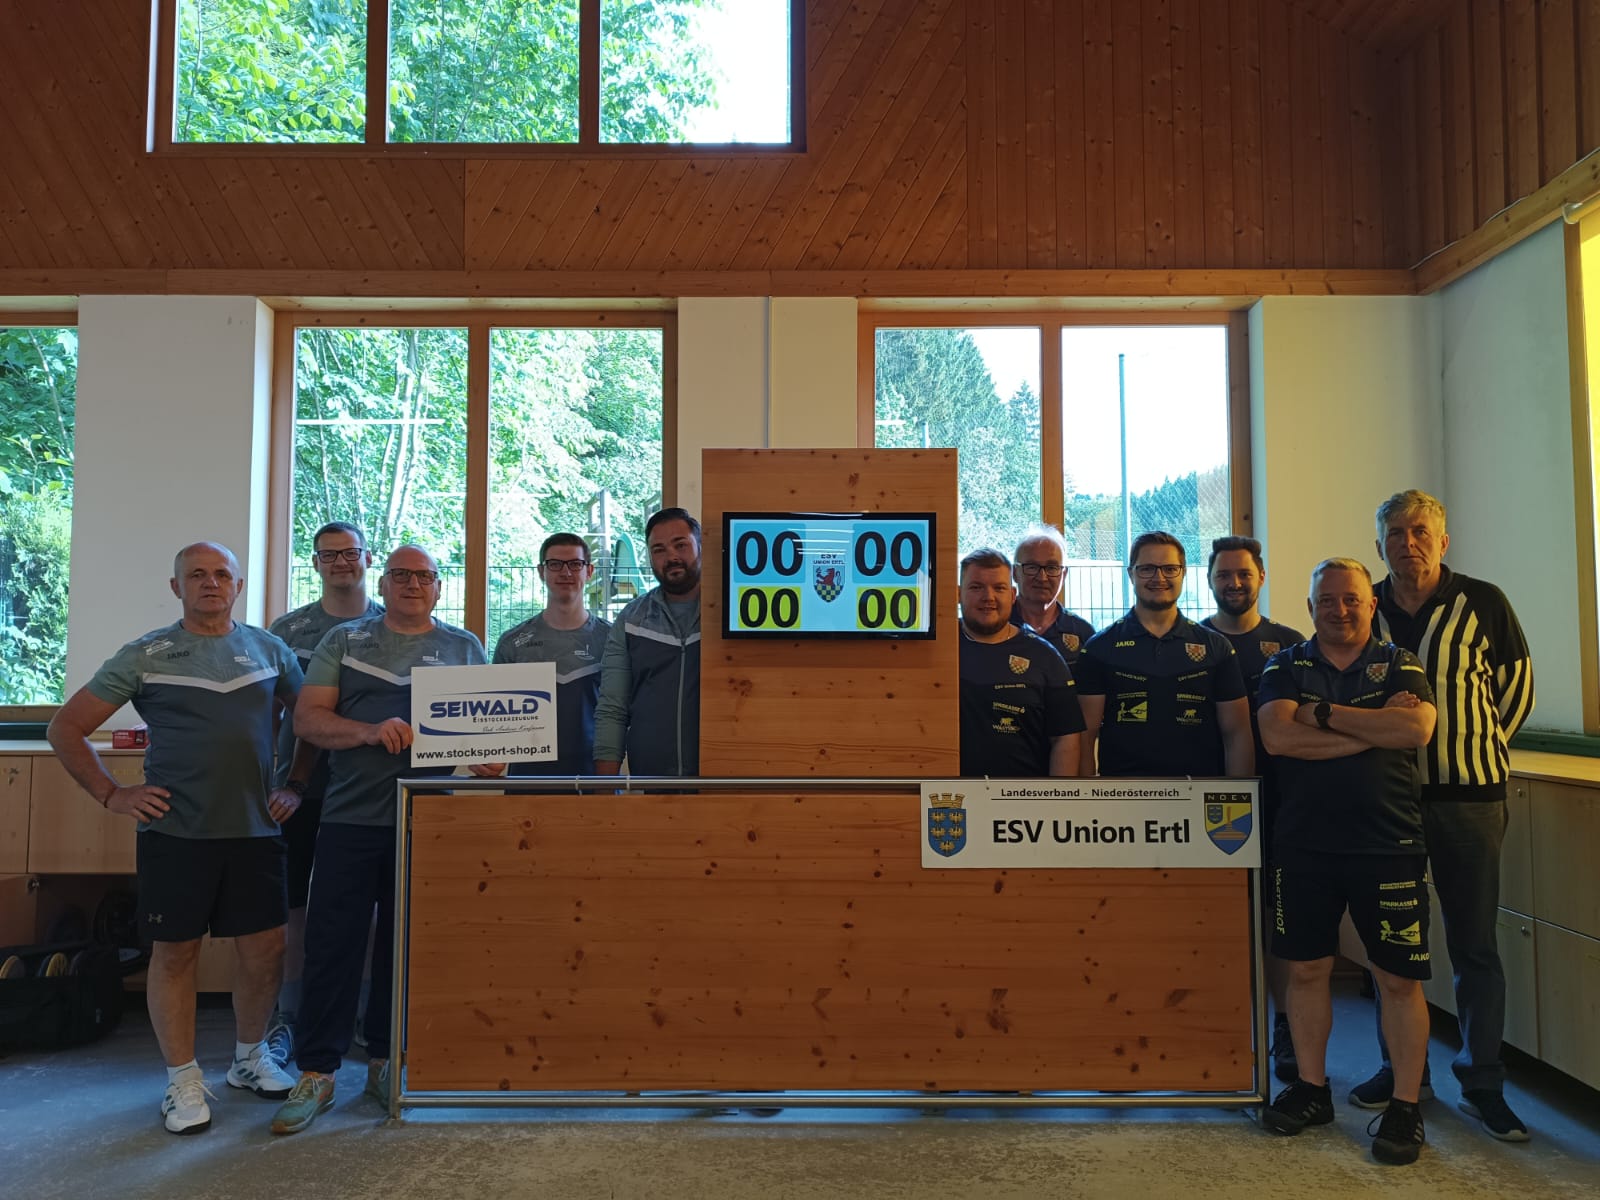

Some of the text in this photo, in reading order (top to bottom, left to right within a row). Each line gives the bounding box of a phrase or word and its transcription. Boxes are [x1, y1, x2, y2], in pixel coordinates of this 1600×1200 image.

[736, 530, 804, 576] 00
[855, 531, 923, 577] 00
[739, 588, 800, 628] 00
[858, 588, 917, 628] 00
[1115, 640, 1136, 648] JAKO
[430, 698, 539, 719] SEIWALD
[416, 744, 551, 760] www.stocksport-shop.at
[1001, 788, 1080, 798] Landesverband
[1092, 788, 1180, 798] Niederösterreich
[993, 818, 1191, 843] ESV Union Ertl
[1408, 952, 1430, 961] JAKO
